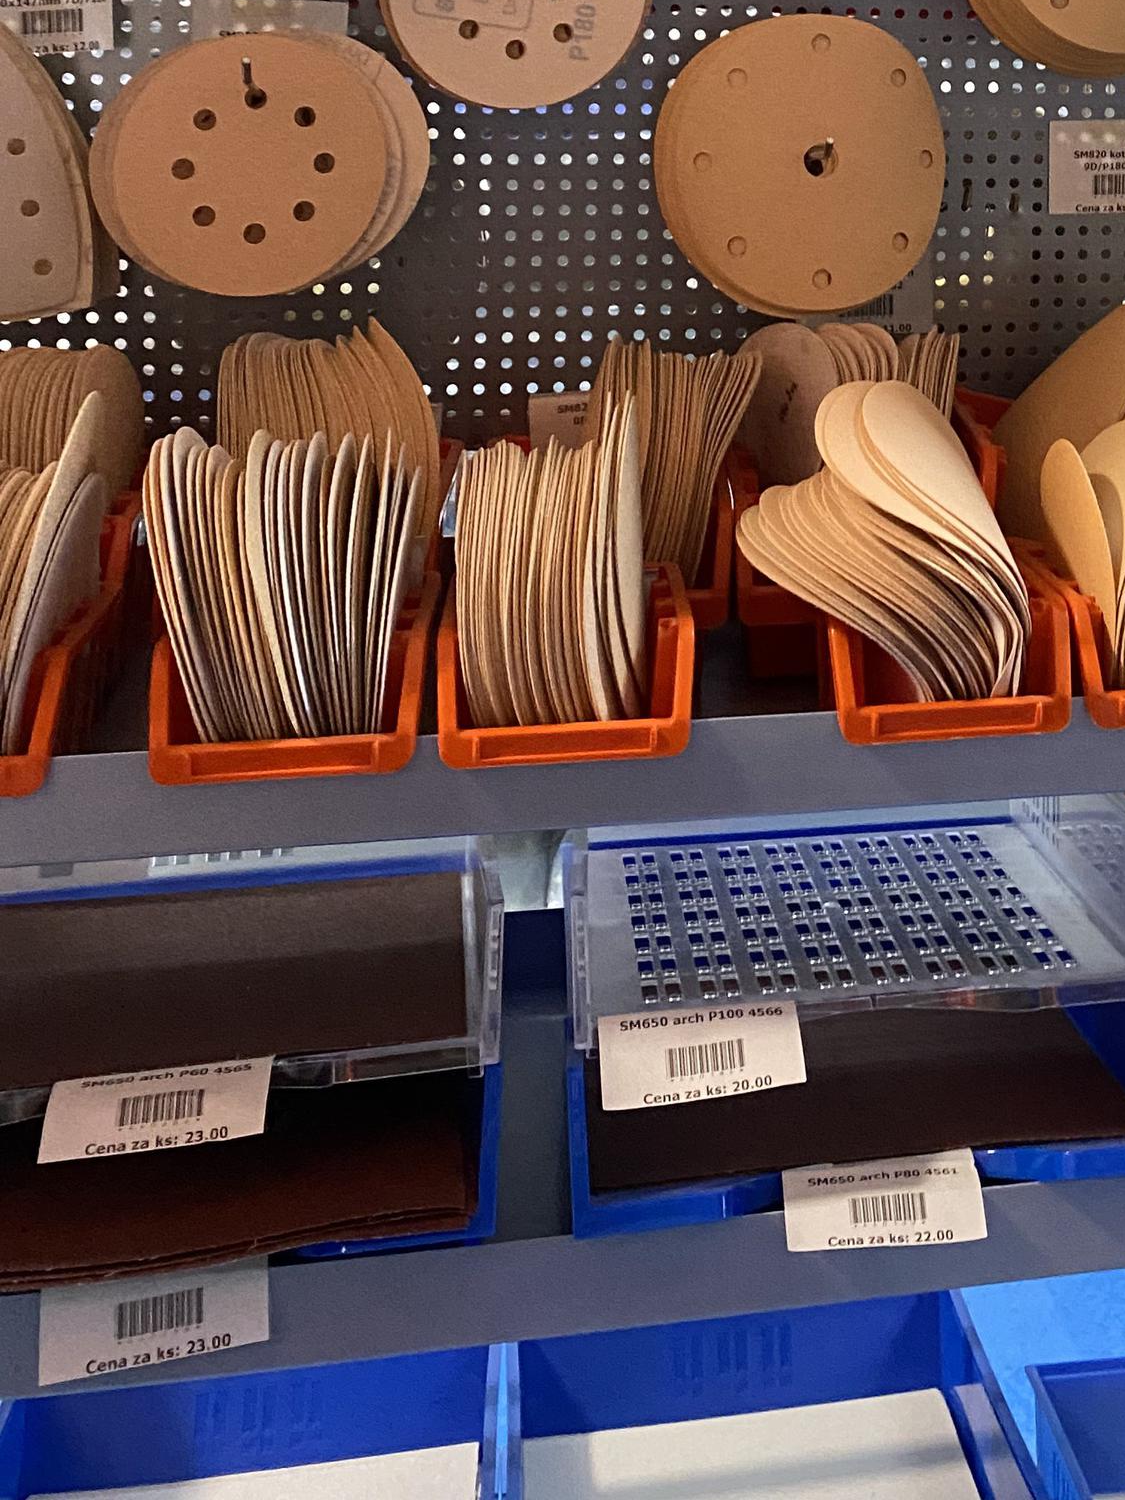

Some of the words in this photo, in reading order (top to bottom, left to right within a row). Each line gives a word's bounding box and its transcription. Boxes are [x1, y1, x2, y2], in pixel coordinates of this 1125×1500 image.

[568, 4, 597, 62] P180
[1074, 150, 1107, 159] SM820
[1075, 204, 1100, 212] Cena
[1103, 204, 1114, 212] za
[620, 1016, 668, 1032] SM650
[673, 1012, 704, 1026] arch
[709, 1008, 743, 1022] P100
[749, 1006, 783, 1018] 4566
[81, 1076, 134, 1088] SM650
[140, 1071, 174, 1081] arch
[179, 1067, 208, 1078] P60
[214, 1063, 252, 1075] 4565
[643, 1092, 680, 1105] Cena
[685, 1090, 701, 1099] za
[706, 1083, 727, 1097] ks:
[732, 1075, 772, 1092] 20.00
[85, 1141, 126, 1156] Cena
[131, 1140, 149, 1150] za
[156, 1134, 178, 1148] ks:
[185, 1126, 228, 1143] 23.00
[808, 1175, 854, 1187] SM650
[859, 1171, 890, 1182] arch
[894, 1169, 920, 1179] P80
[923, 1167, 957, 1176] 4561
[828, 1236, 864, 1247] Cena
[868, 1235, 884, 1244] za
[890, 1233, 909, 1244] ks:
[915, 1230, 953, 1242] 22.00
[86, 1358, 127, 1374] Cena
[133, 1352, 150, 1365] za
[157, 1345, 180, 1360] ks:
[187, 1333, 231, 1355] 23.00
